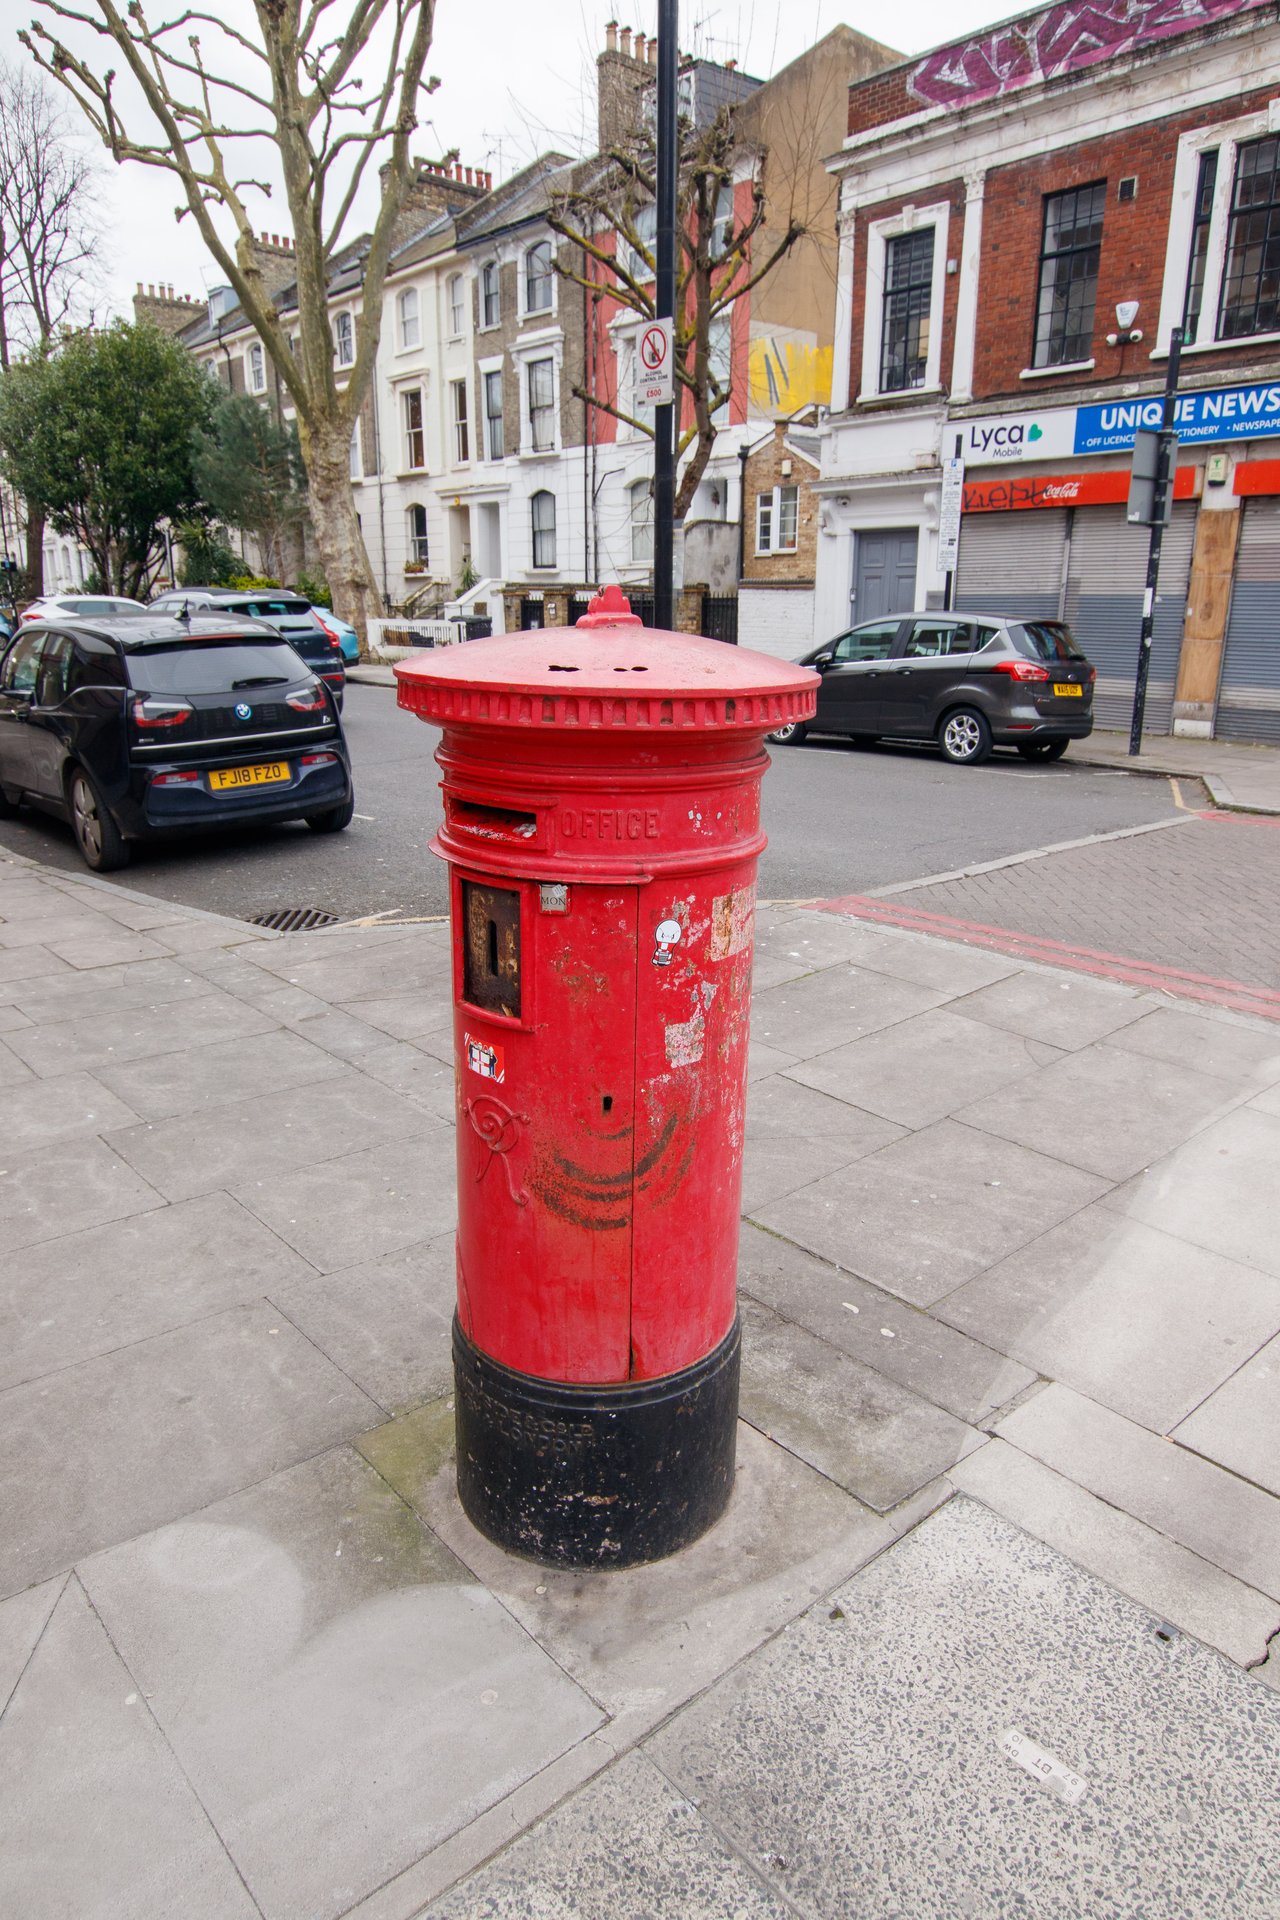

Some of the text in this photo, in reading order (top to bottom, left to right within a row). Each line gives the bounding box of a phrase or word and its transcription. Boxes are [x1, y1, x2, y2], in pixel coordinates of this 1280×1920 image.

[646, 388, 661, 398] £500
[1202, 387, 1280, 419] NEWS
[971, 425, 1024, 452] Lyca
[1086, 437, 1102, 447] OFF
[1103, 433, 1136, 445] LICENCE
[993, 447, 1022, 458] Mobile
[218, 765, 281, 786] FJ18 FZO
[561, 809, 659, 839] OFFICE
[541, 897, 566, 906] MON
[1032, 1758, 1052, 1774] BT
